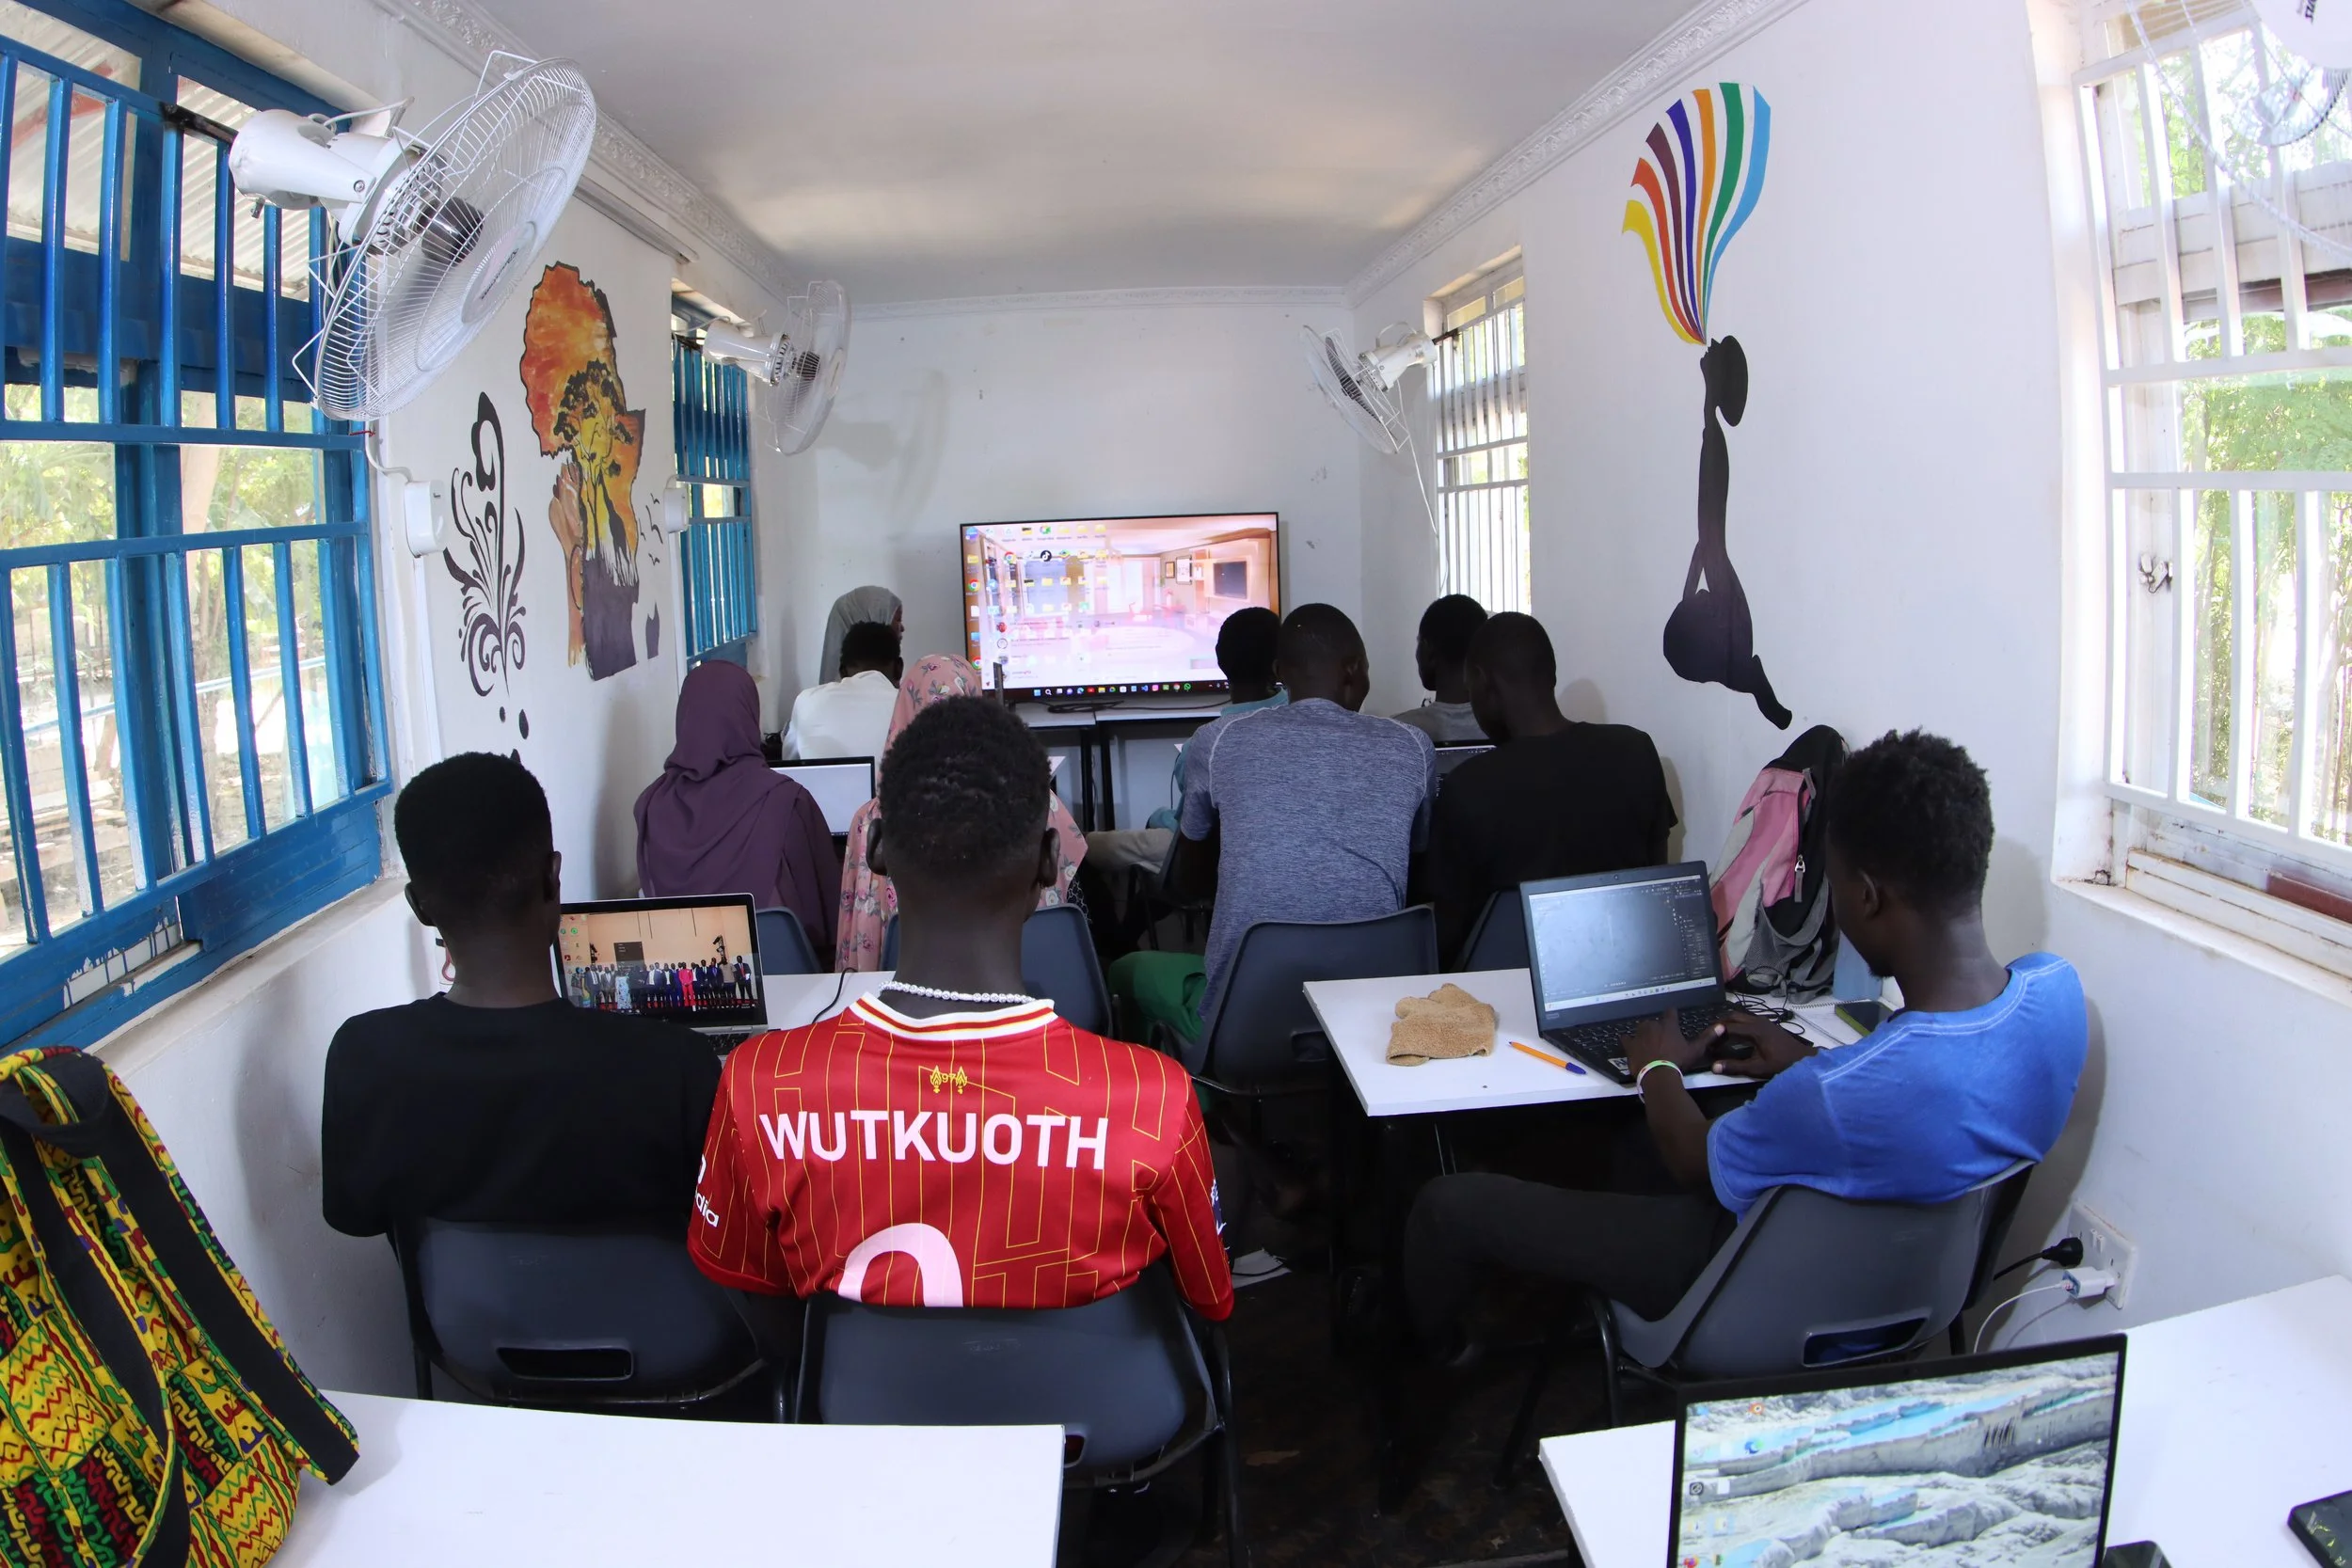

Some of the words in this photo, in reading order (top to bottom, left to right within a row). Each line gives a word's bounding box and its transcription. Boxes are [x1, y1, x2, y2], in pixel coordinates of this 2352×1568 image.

[942, 1072, 957, 1084] 97
[759, 1110, 1108, 1169] WUTKUOTH
[695, 1188, 720, 1227] dia
